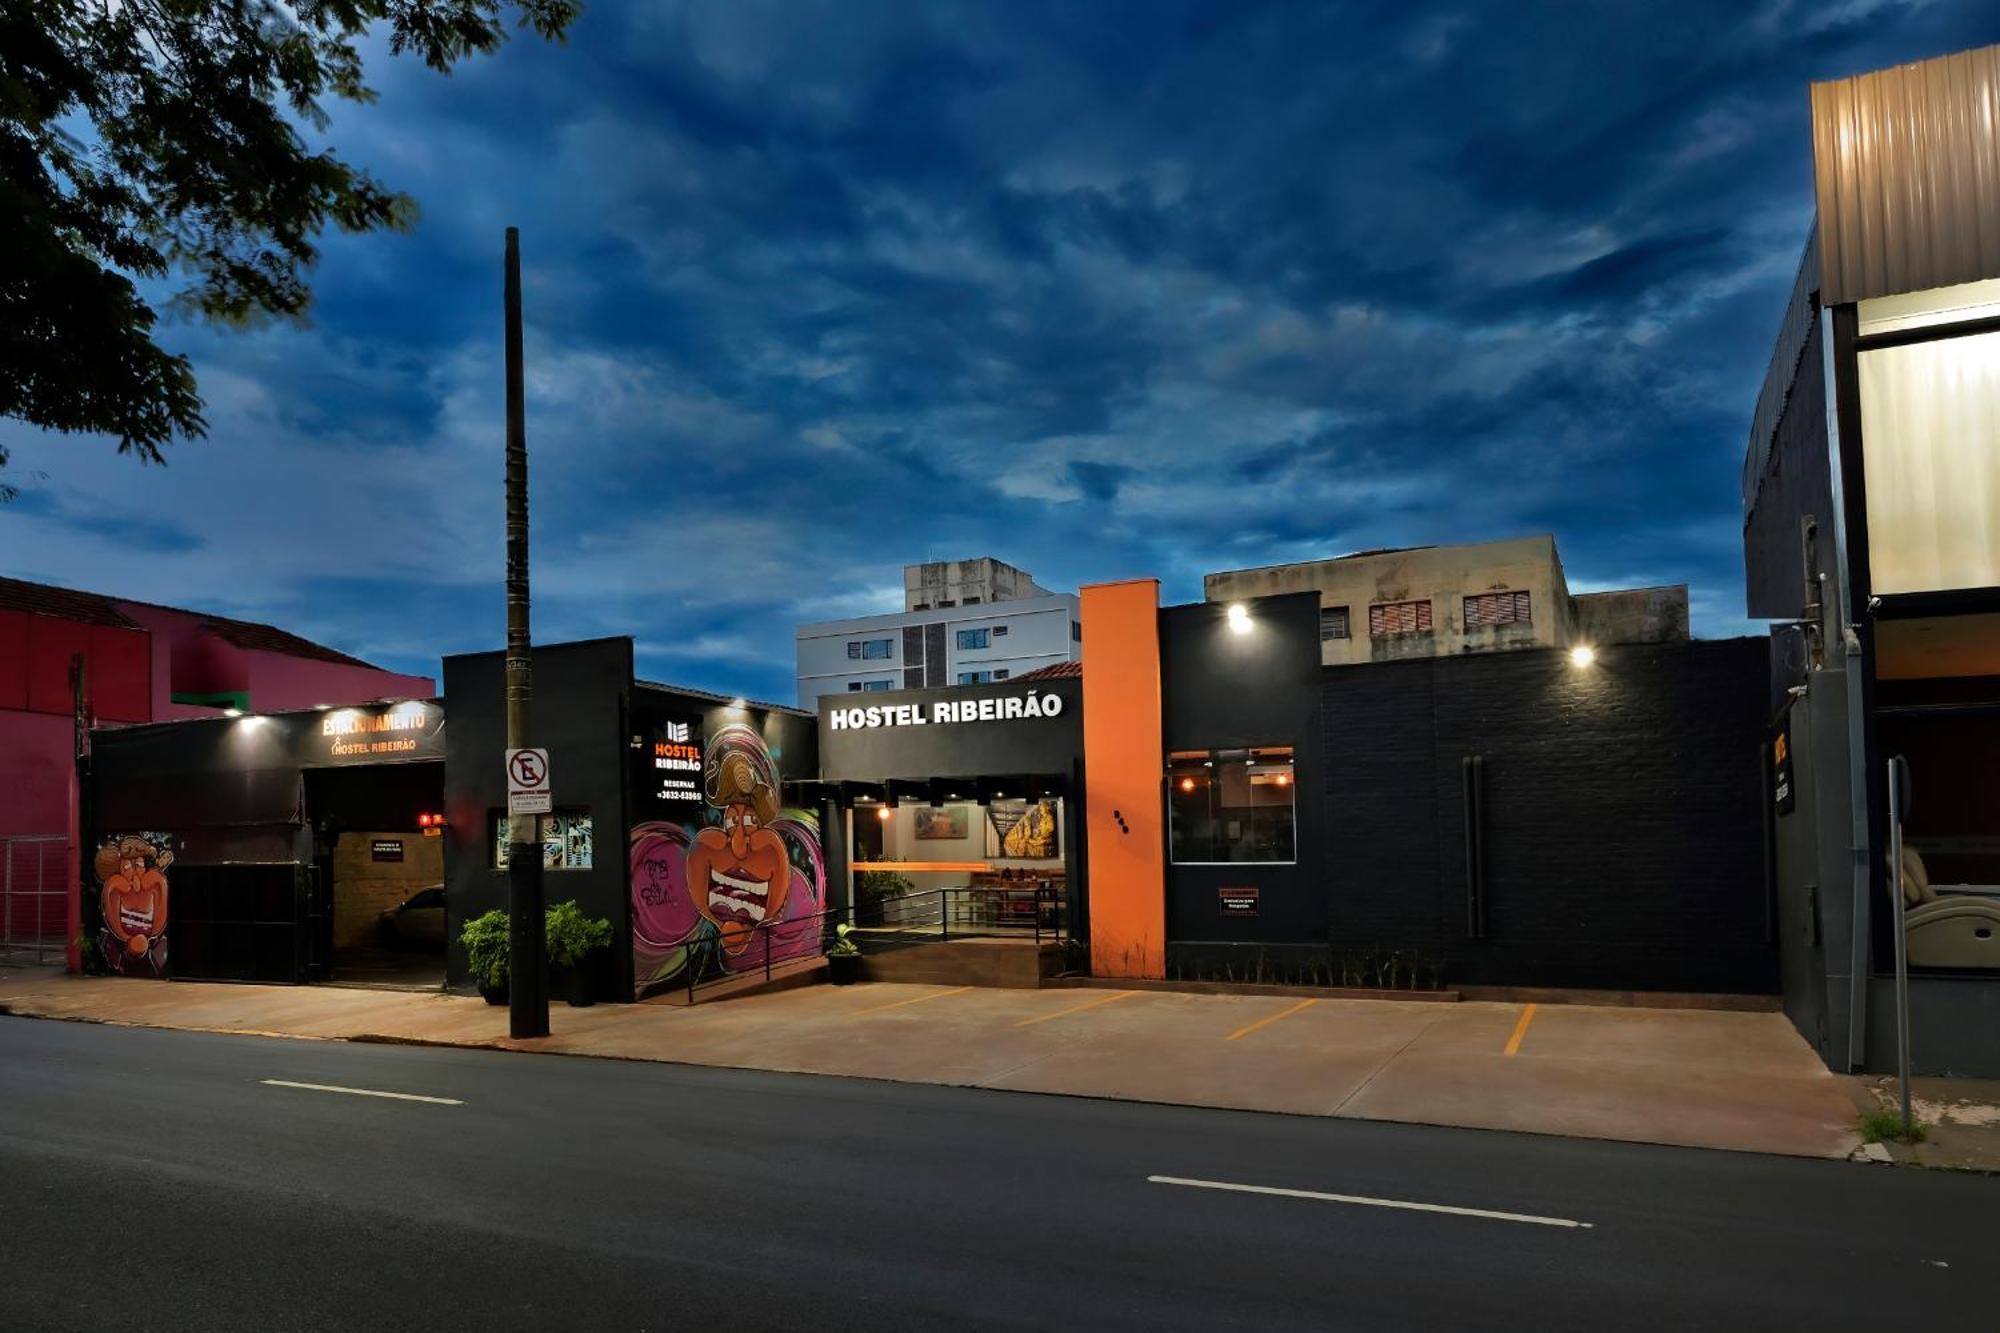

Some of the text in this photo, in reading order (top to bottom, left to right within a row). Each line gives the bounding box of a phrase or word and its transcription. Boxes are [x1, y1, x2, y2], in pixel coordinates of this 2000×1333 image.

[830, 690, 1063, 730] HOSTEL RIBEIRÃO
[335, 742, 370, 755] HOSTEL
[655, 743, 701, 759] HOSTEL
[655, 757, 702, 771] RIBEIRÃO
